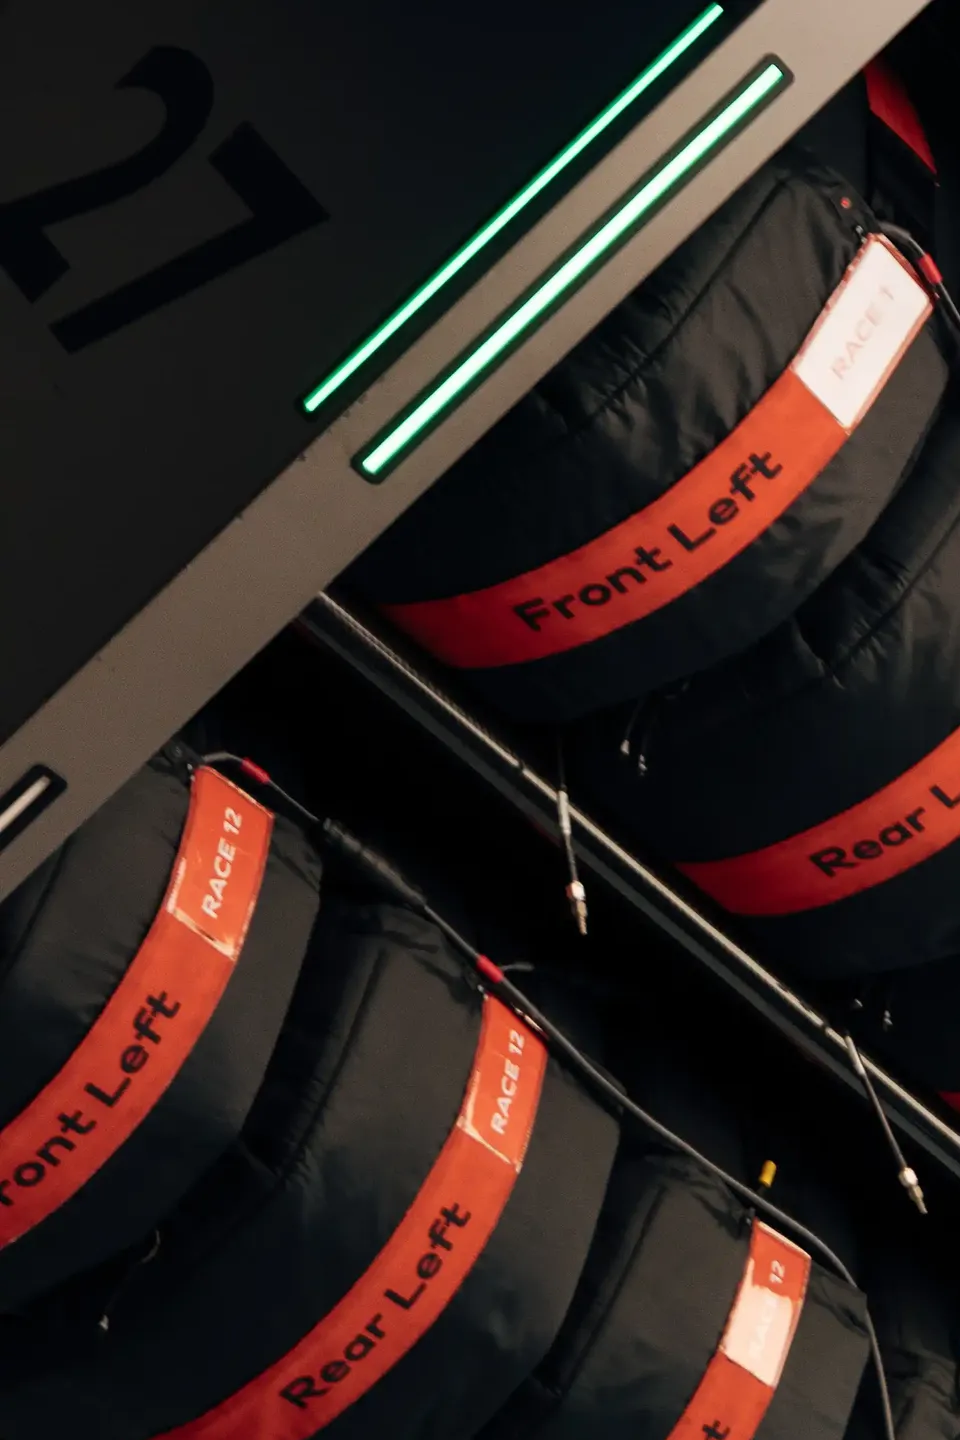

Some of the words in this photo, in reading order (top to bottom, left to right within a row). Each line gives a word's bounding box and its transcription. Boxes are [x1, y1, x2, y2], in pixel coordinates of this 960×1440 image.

[0, 45, 331, 355] 27
[828, 304, 888, 381] RACE
[512, 544, 675, 632] Front
[666, 450, 783, 552] Left
[201, 837, 238, 919] RACE
[223, 807, 243, 837] 12
[808, 806, 926, 878] Rear
[0, 1108, 97, 1207] ront
[84, 990, 182, 1108] Left
[491, 1059, 521, 1135] RACE
[508, 1030, 525, 1060] 12
[278, 1312, 386, 1409] Rear
[383, 1202, 472, 1311] Left
[768, 1259, 786, 1285] 12
